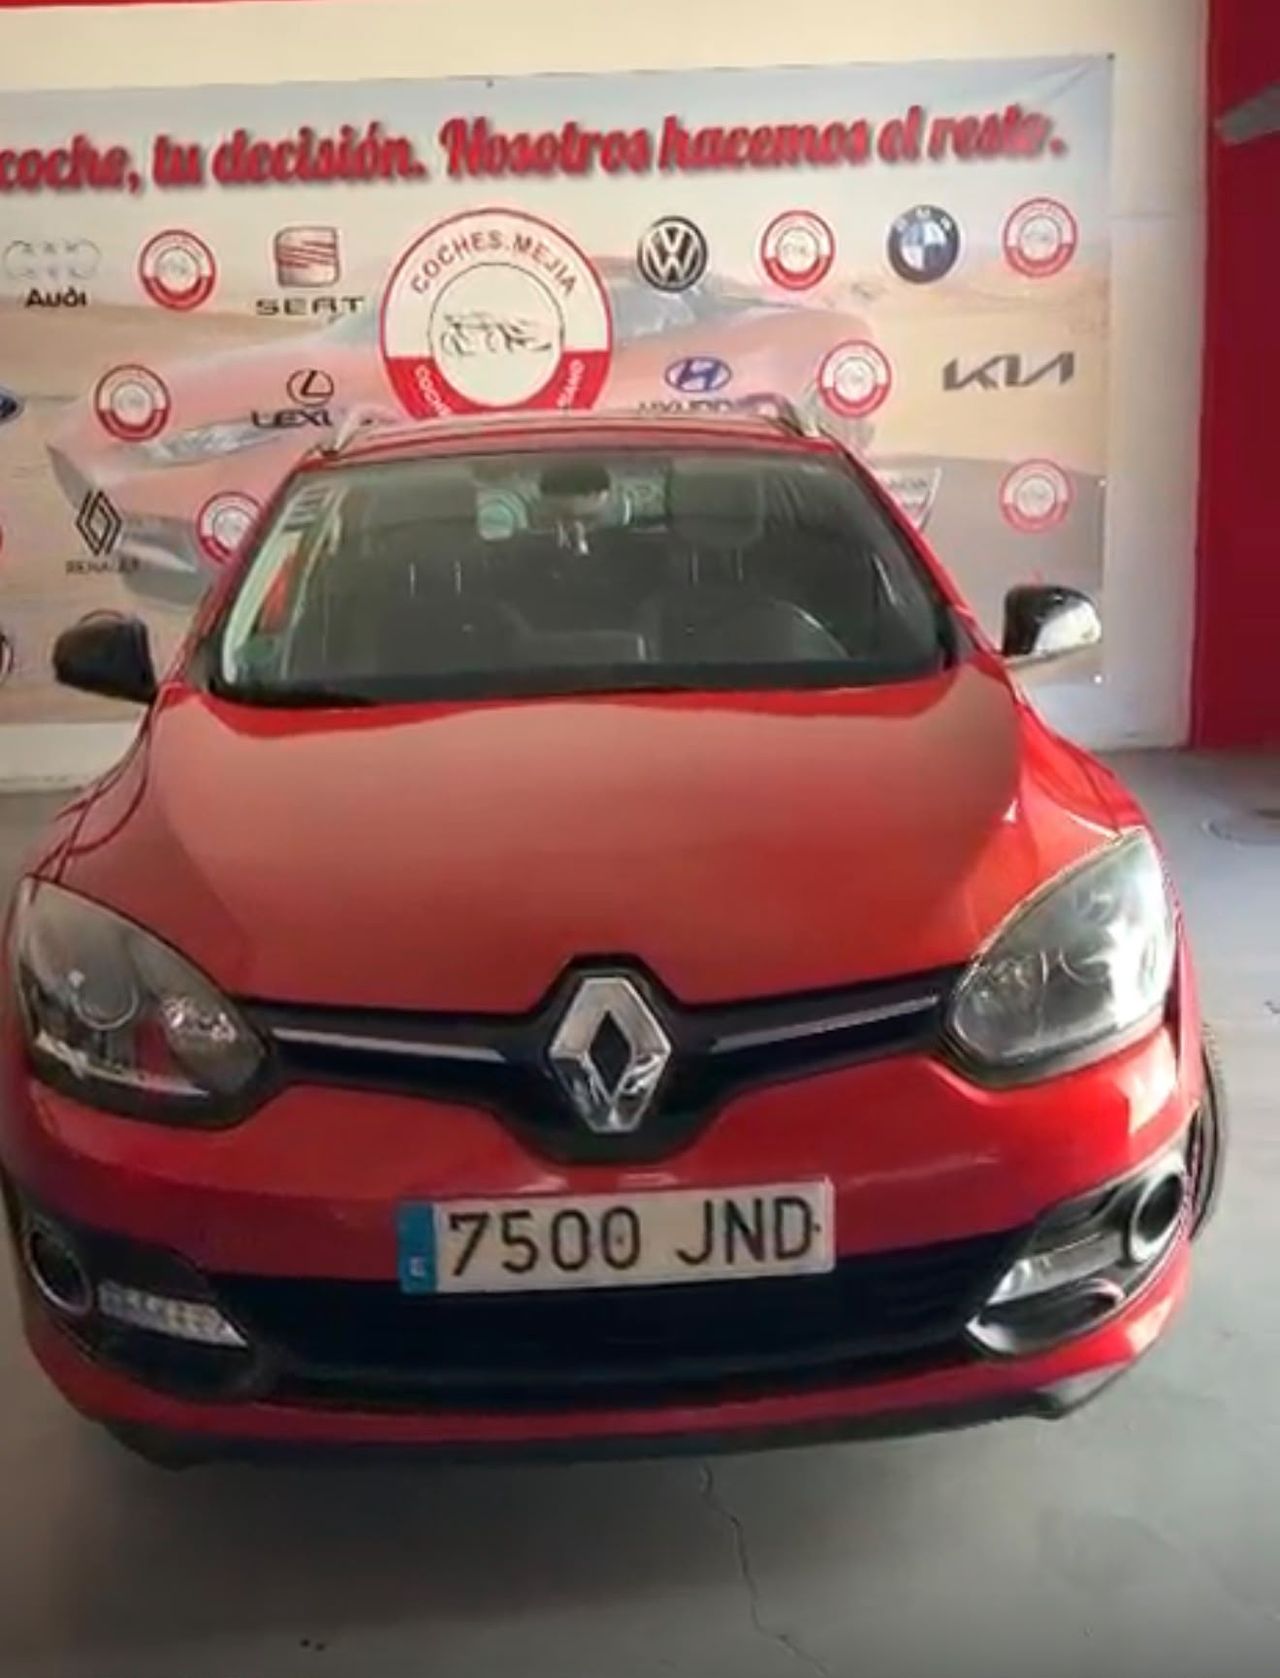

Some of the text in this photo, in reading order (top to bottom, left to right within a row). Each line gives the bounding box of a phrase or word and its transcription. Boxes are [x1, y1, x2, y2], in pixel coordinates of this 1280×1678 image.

[0, 134, 141, 194] coche,
[152, 134, 204, 188] tu
[211, 121, 427, 185] decisión.
[438, 116, 650, 179] Nosotros
[658, 111, 869, 172] hacemos
[876, 104, 925, 163] el
[256, 297, 365, 317] SEAT
[447, 1205, 641, 1277] 7500
[675, 1195, 813, 1266] JND
